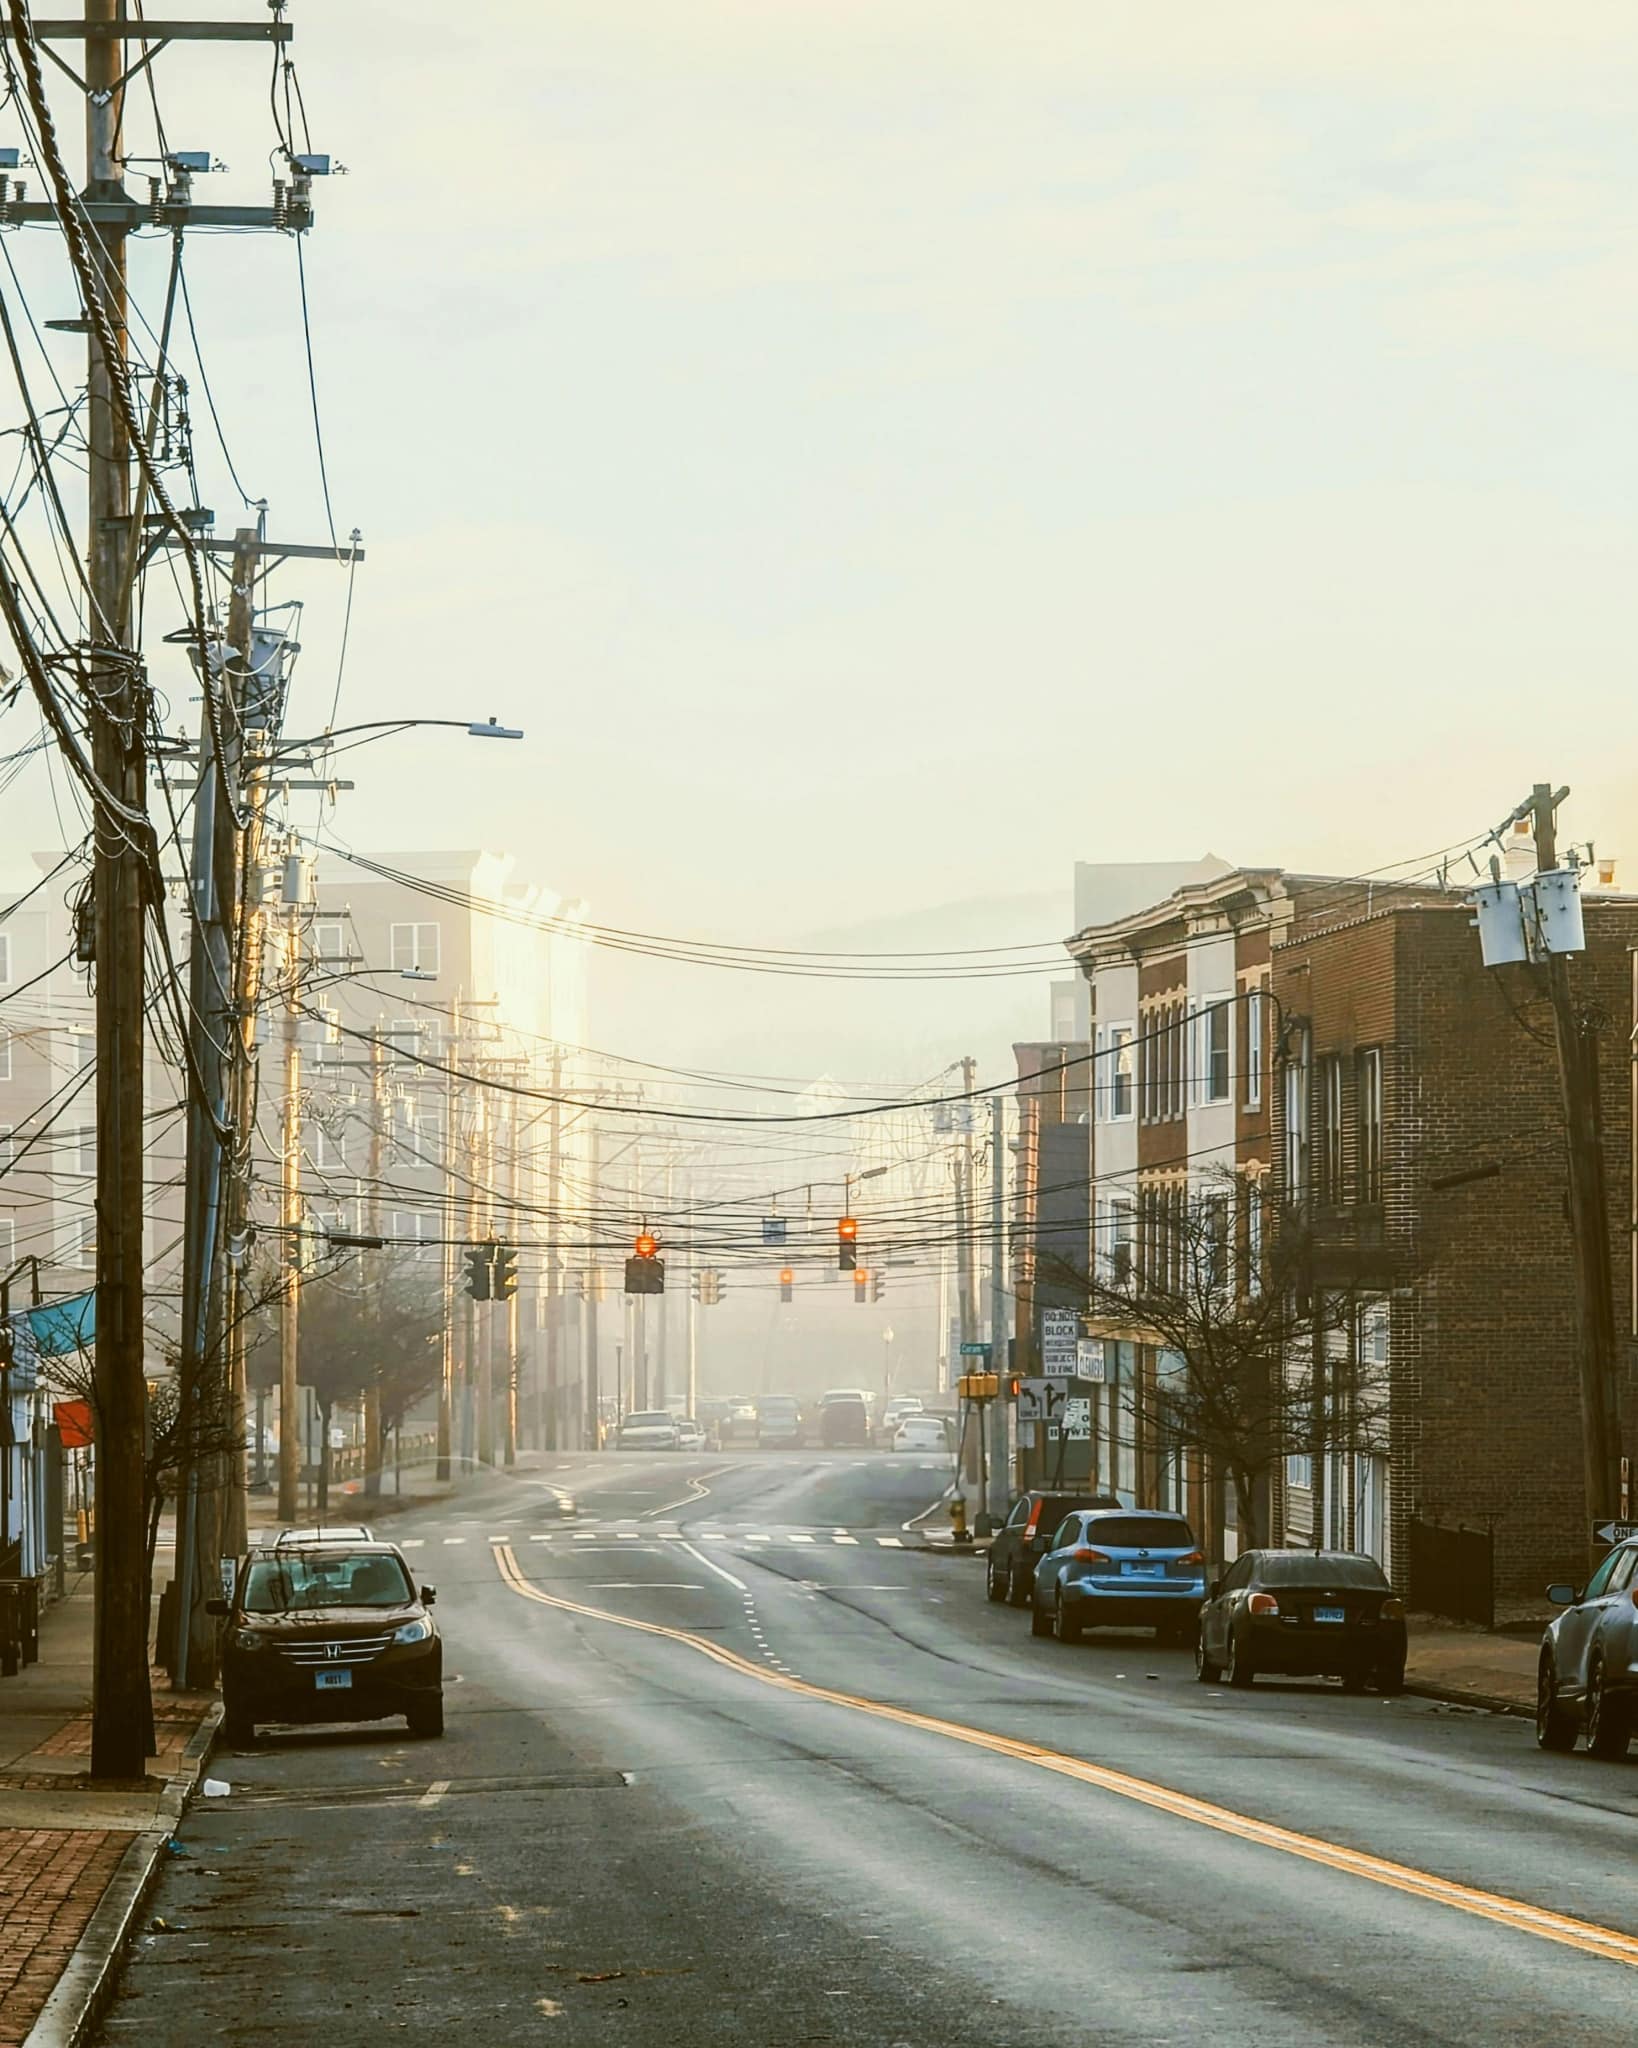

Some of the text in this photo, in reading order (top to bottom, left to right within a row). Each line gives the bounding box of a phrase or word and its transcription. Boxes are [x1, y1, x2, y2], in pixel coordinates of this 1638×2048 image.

[1045, 1311, 1056, 1321] DO
[1045, 1326, 1074, 1336] BLOCK
[1613, 1527, 1635, 1538] ONE
